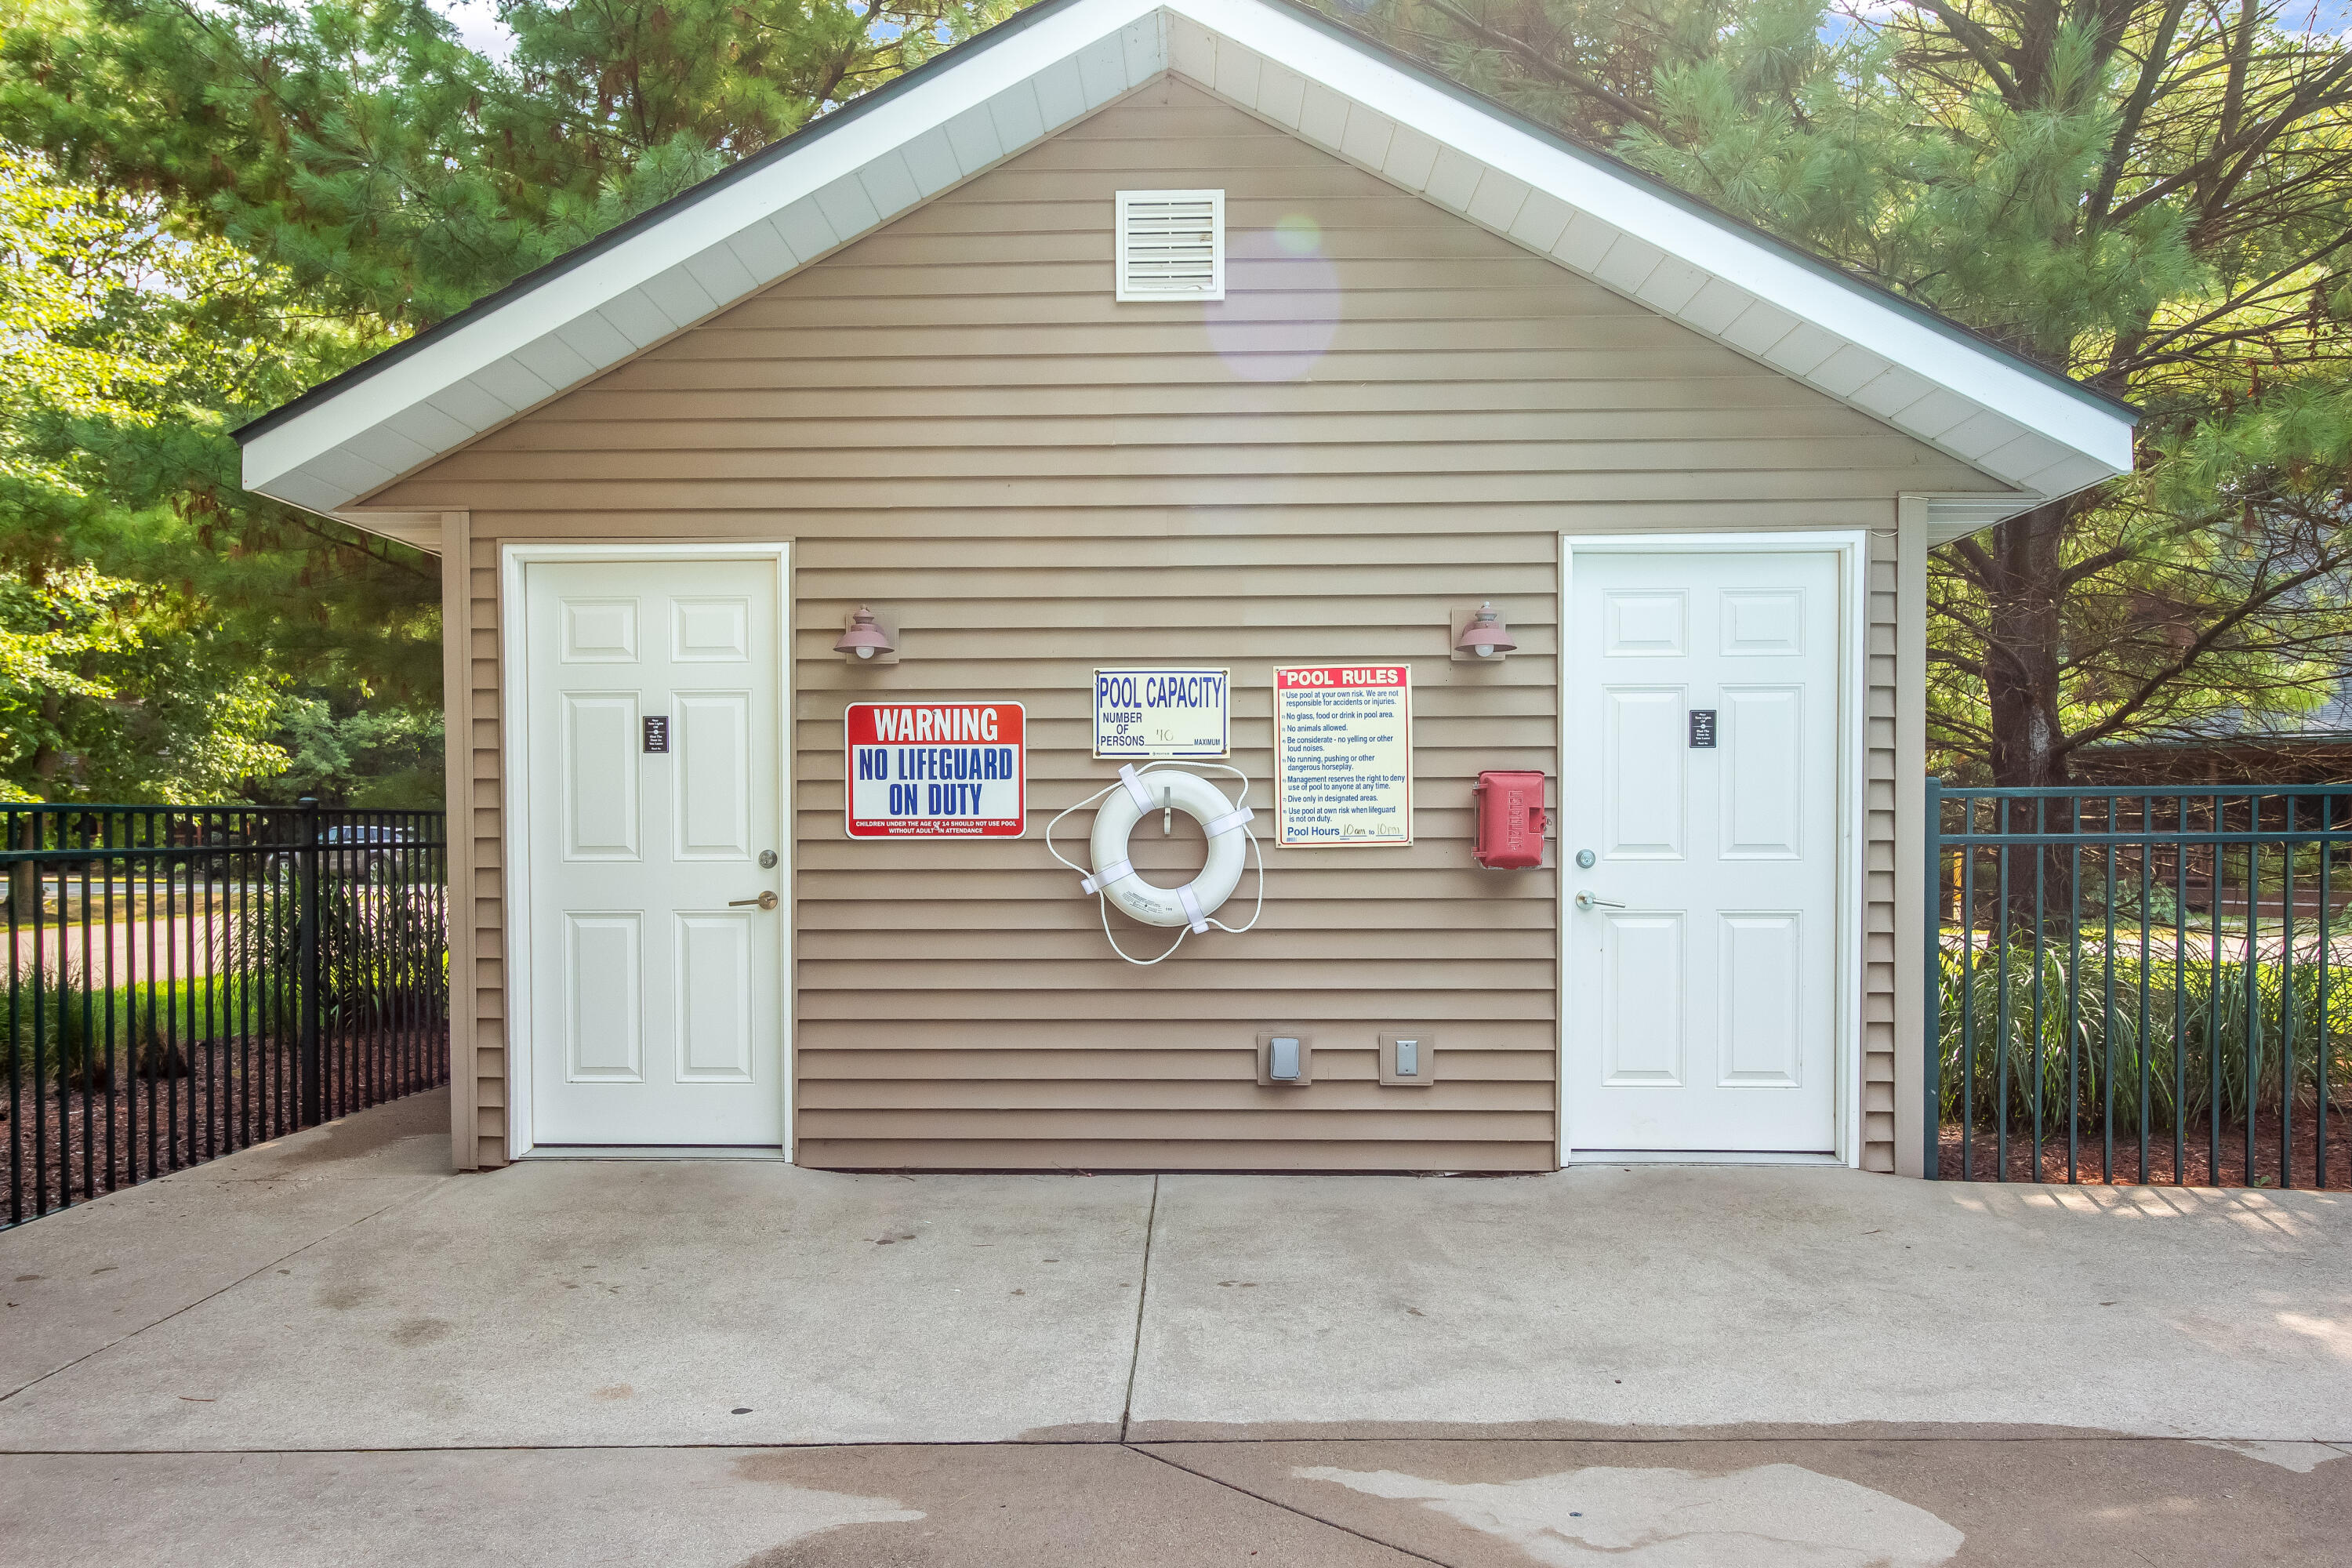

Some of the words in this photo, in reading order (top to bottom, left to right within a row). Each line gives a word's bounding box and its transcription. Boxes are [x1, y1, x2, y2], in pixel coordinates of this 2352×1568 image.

[1287, 671, 1334, 685] POOL
[1342, 670, 1398, 684] RULES
[1100, 677, 1142, 708] POOL
[1146, 677, 1222, 708] CAPACITY
[1300, 691, 1312, 700] pool
[1287, 699, 1321, 708] responsible
[1372, 698, 1396, 706] injuries.
[1103, 713, 1142, 723] NUMBER
[1297, 713, 1314, 721] glass,
[873, 708, 997, 741] WARNING
[1116, 724, 1128, 734] OF
[1101, 736, 1145, 746] PERSONS
[1348, 735, 1367, 744] yelling
[1324, 754, 1348, 763] pushing
[859, 749, 887, 780] NO
[898, 748, 1012, 780] LIFEGUARD
[1288, 764, 1319, 772] dangerous
[1322, 763, 1353, 771] horseplay.
[1367, 775, 1381, 783] right
[1309, 783, 1322, 792] pool
[890, 784, 917, 815] ON
[928, 784, 982, 815] DUTY
[1303, 795, 1316, 804] only
[1325, 794, 1358, 803] designated
[1302, 807, 1315, 815] pool
[1317, 815, 1332, 823] duty.
[1287, 826, 1308, 836] Pool
[1312, 826, 1339, 835] Hours
